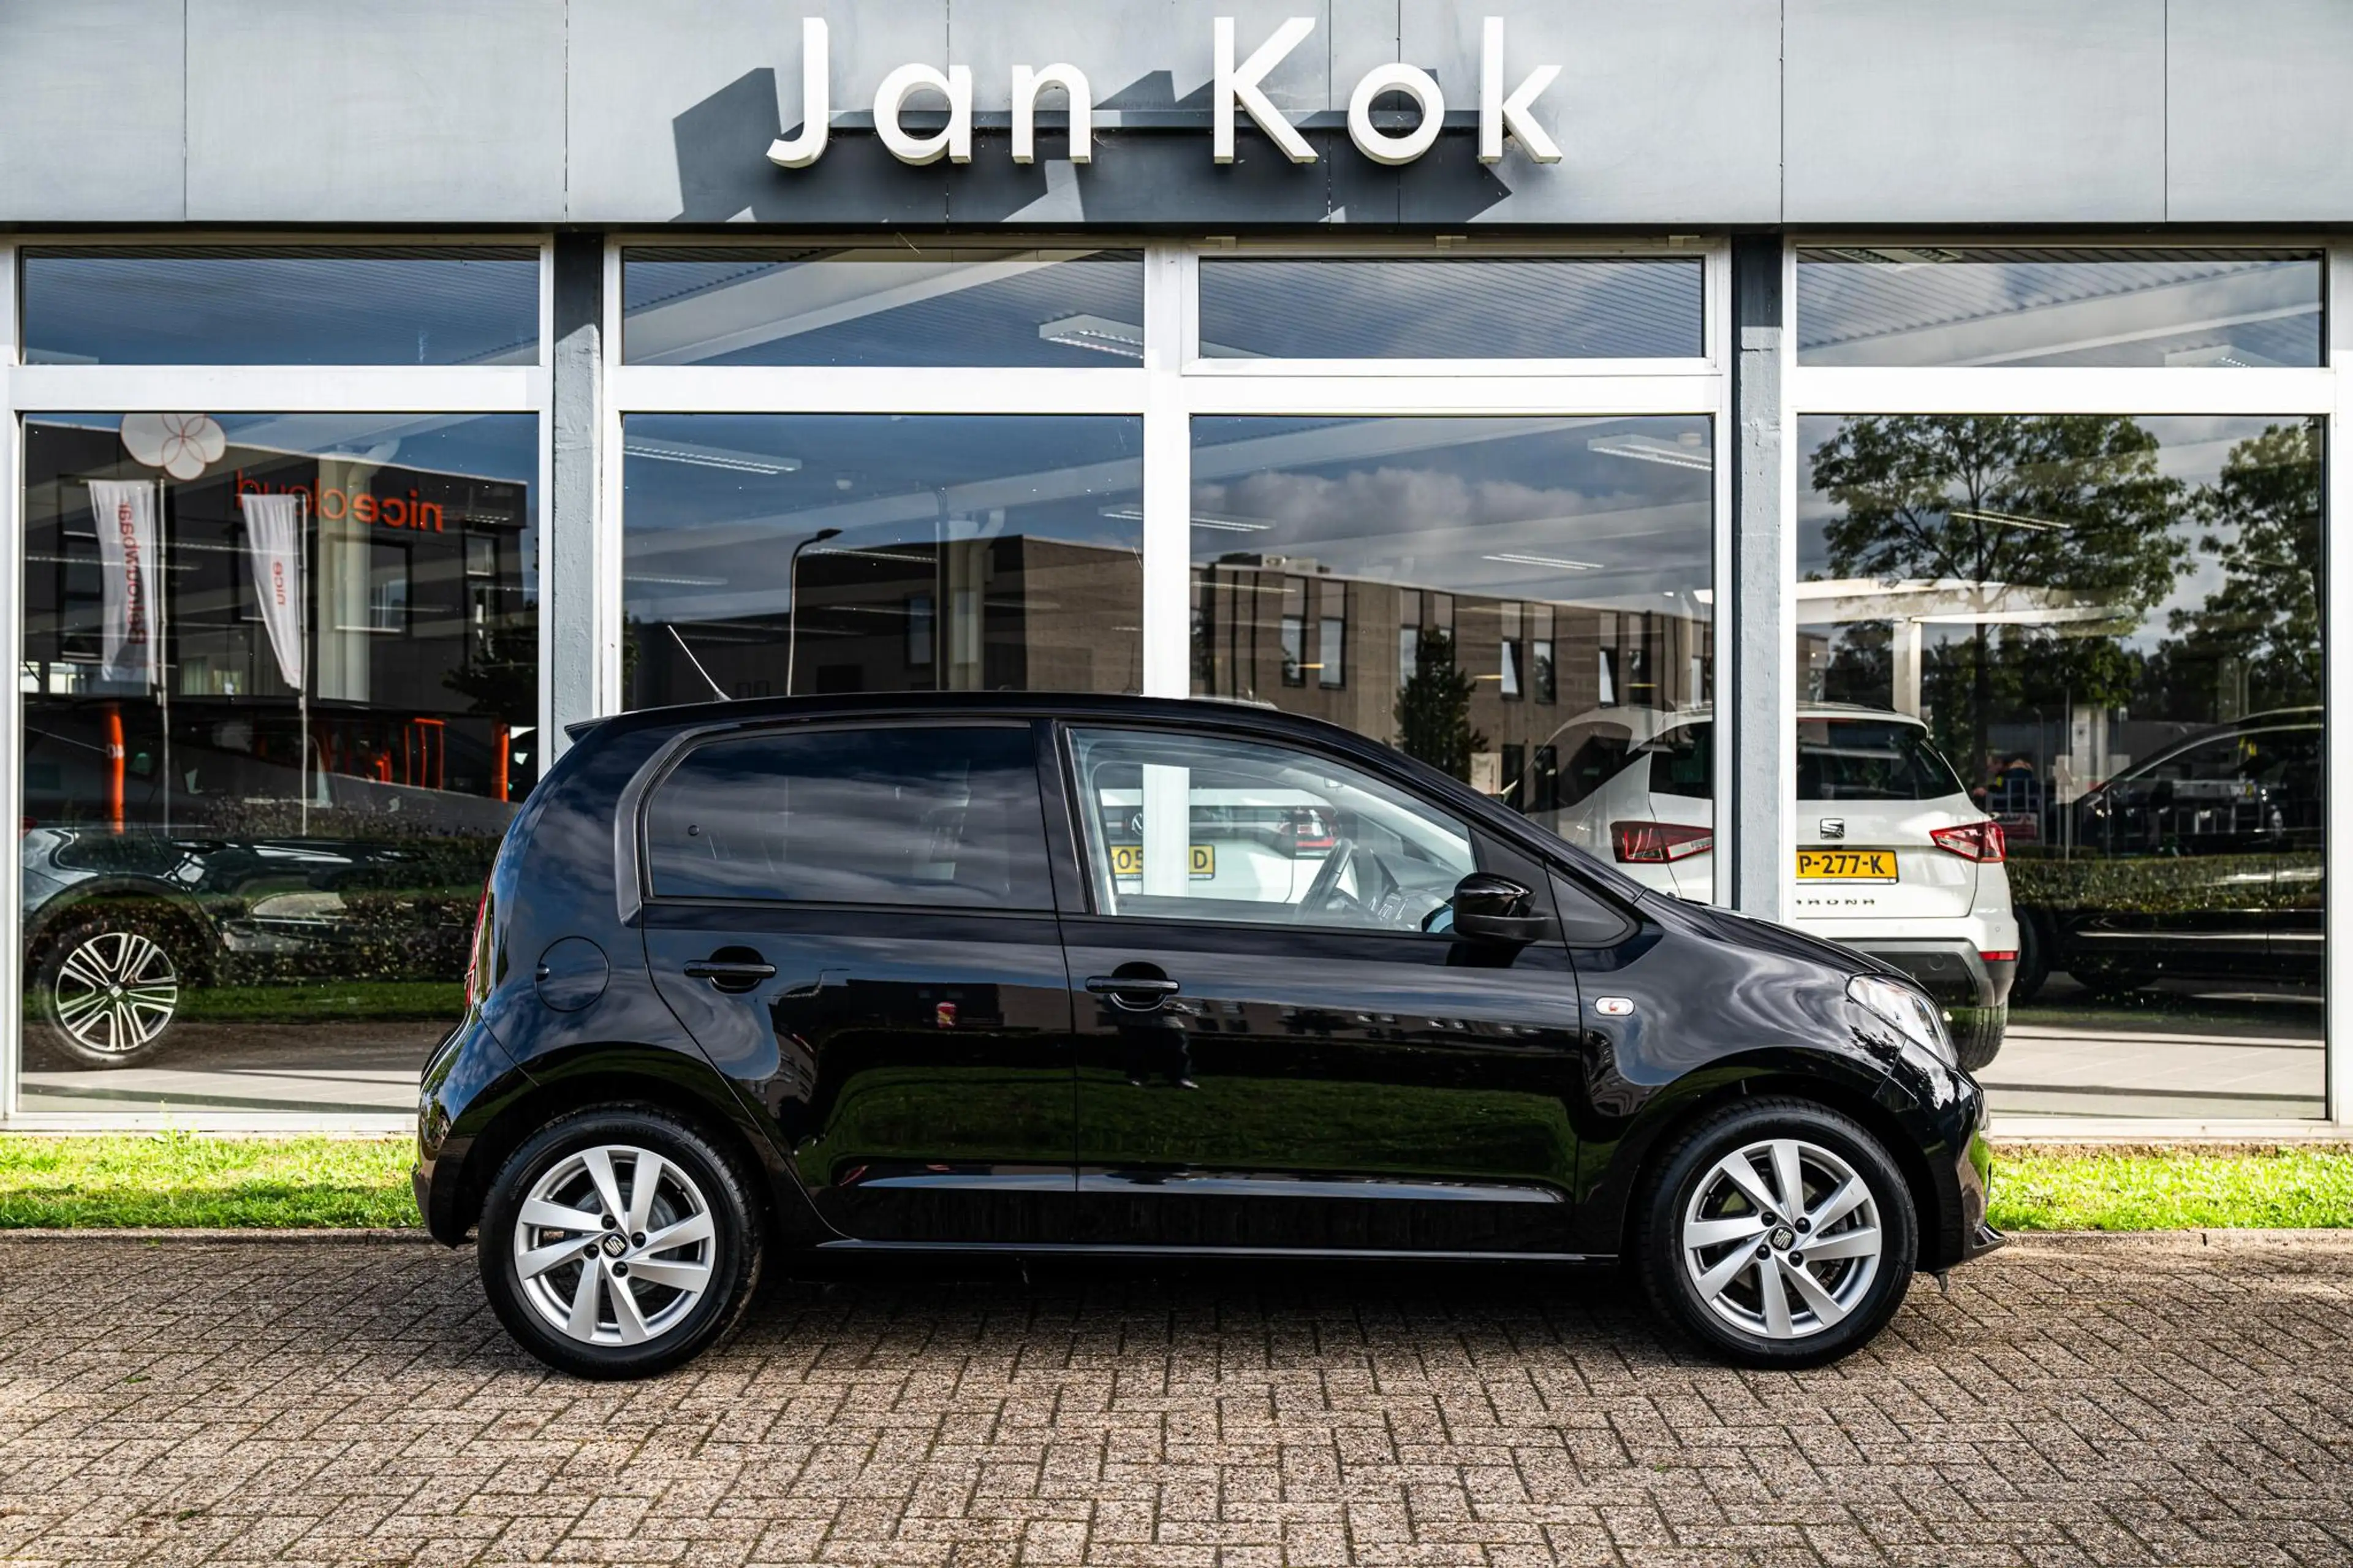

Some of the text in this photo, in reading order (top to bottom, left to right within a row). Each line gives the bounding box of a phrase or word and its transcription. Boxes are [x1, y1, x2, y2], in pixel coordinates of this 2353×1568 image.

[767, 17, 1563, 167] Jan Kok
[1799, 855, 1885, 874] P-277-K
